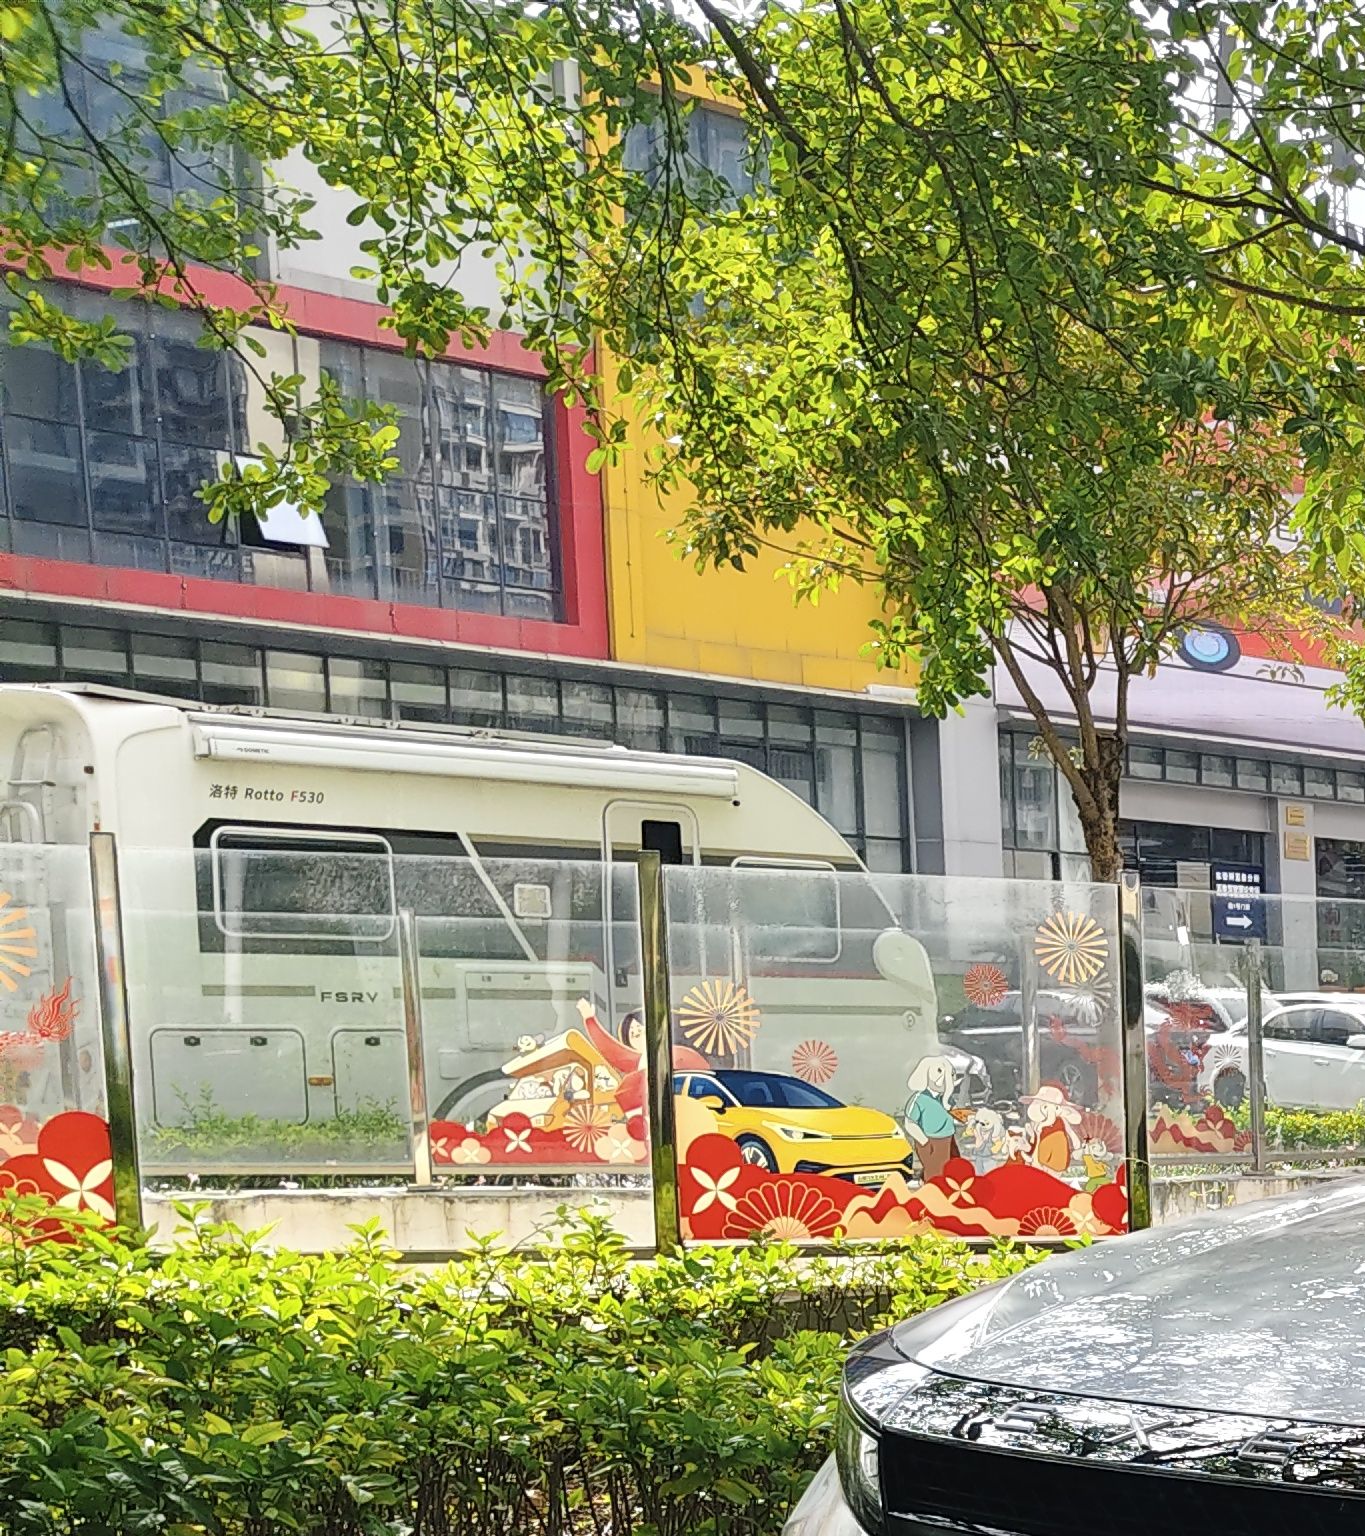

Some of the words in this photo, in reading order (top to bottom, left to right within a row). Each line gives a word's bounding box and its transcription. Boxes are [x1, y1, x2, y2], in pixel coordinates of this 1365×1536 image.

[209, 784, 238, 800] 洛特
[244, 787, 284, 802] Rotto
[290, 790, 325, 804] F530
[320, 991, 378, 1003] FSRV
